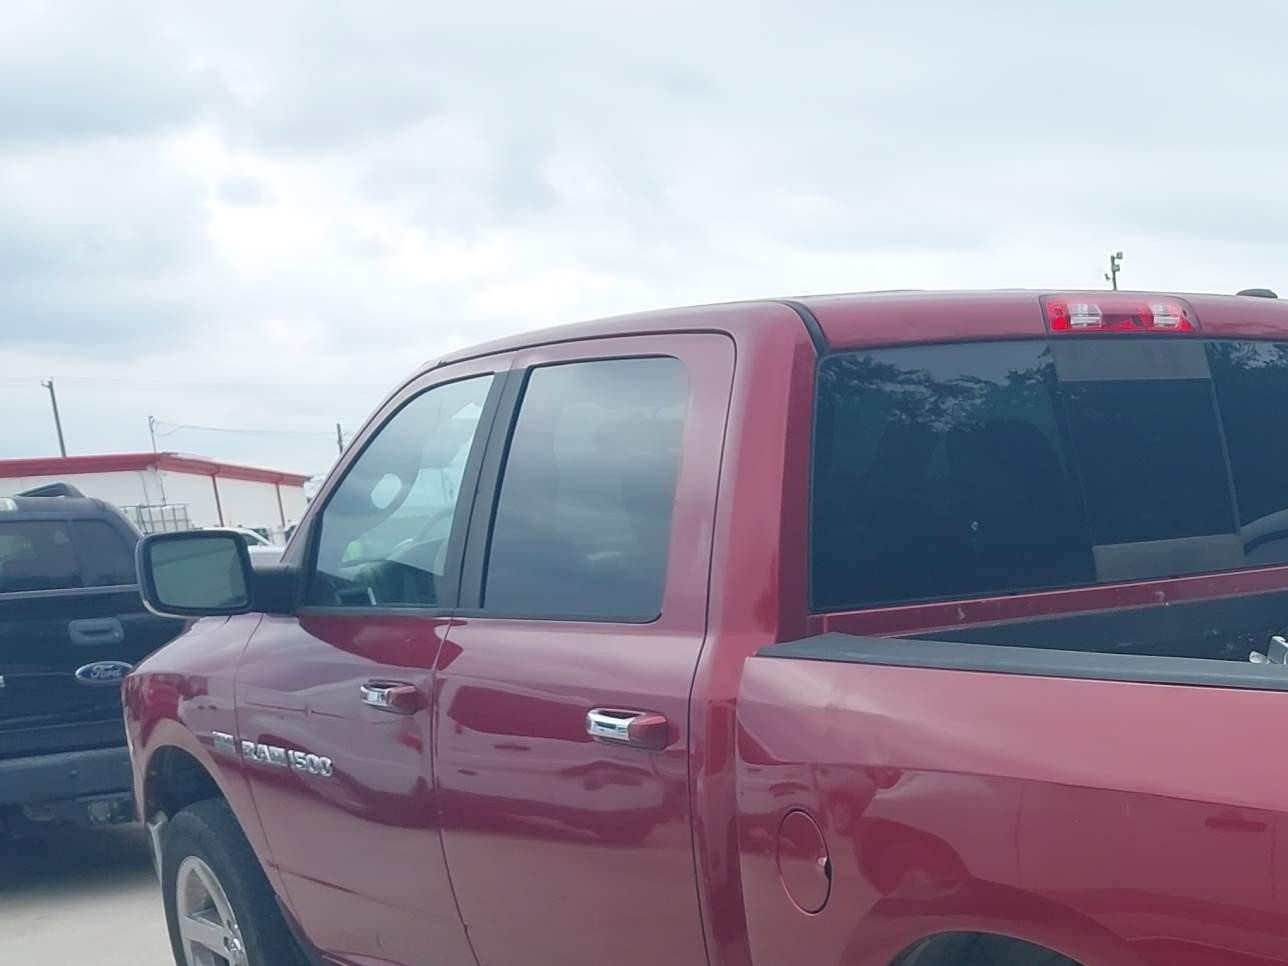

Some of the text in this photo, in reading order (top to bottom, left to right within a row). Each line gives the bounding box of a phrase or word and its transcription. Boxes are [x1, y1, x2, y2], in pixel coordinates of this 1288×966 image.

[90, 664, 121, 679] Ford
[241, 740, 287, 766] RAM
[288, 750, 333, 777] 1500
